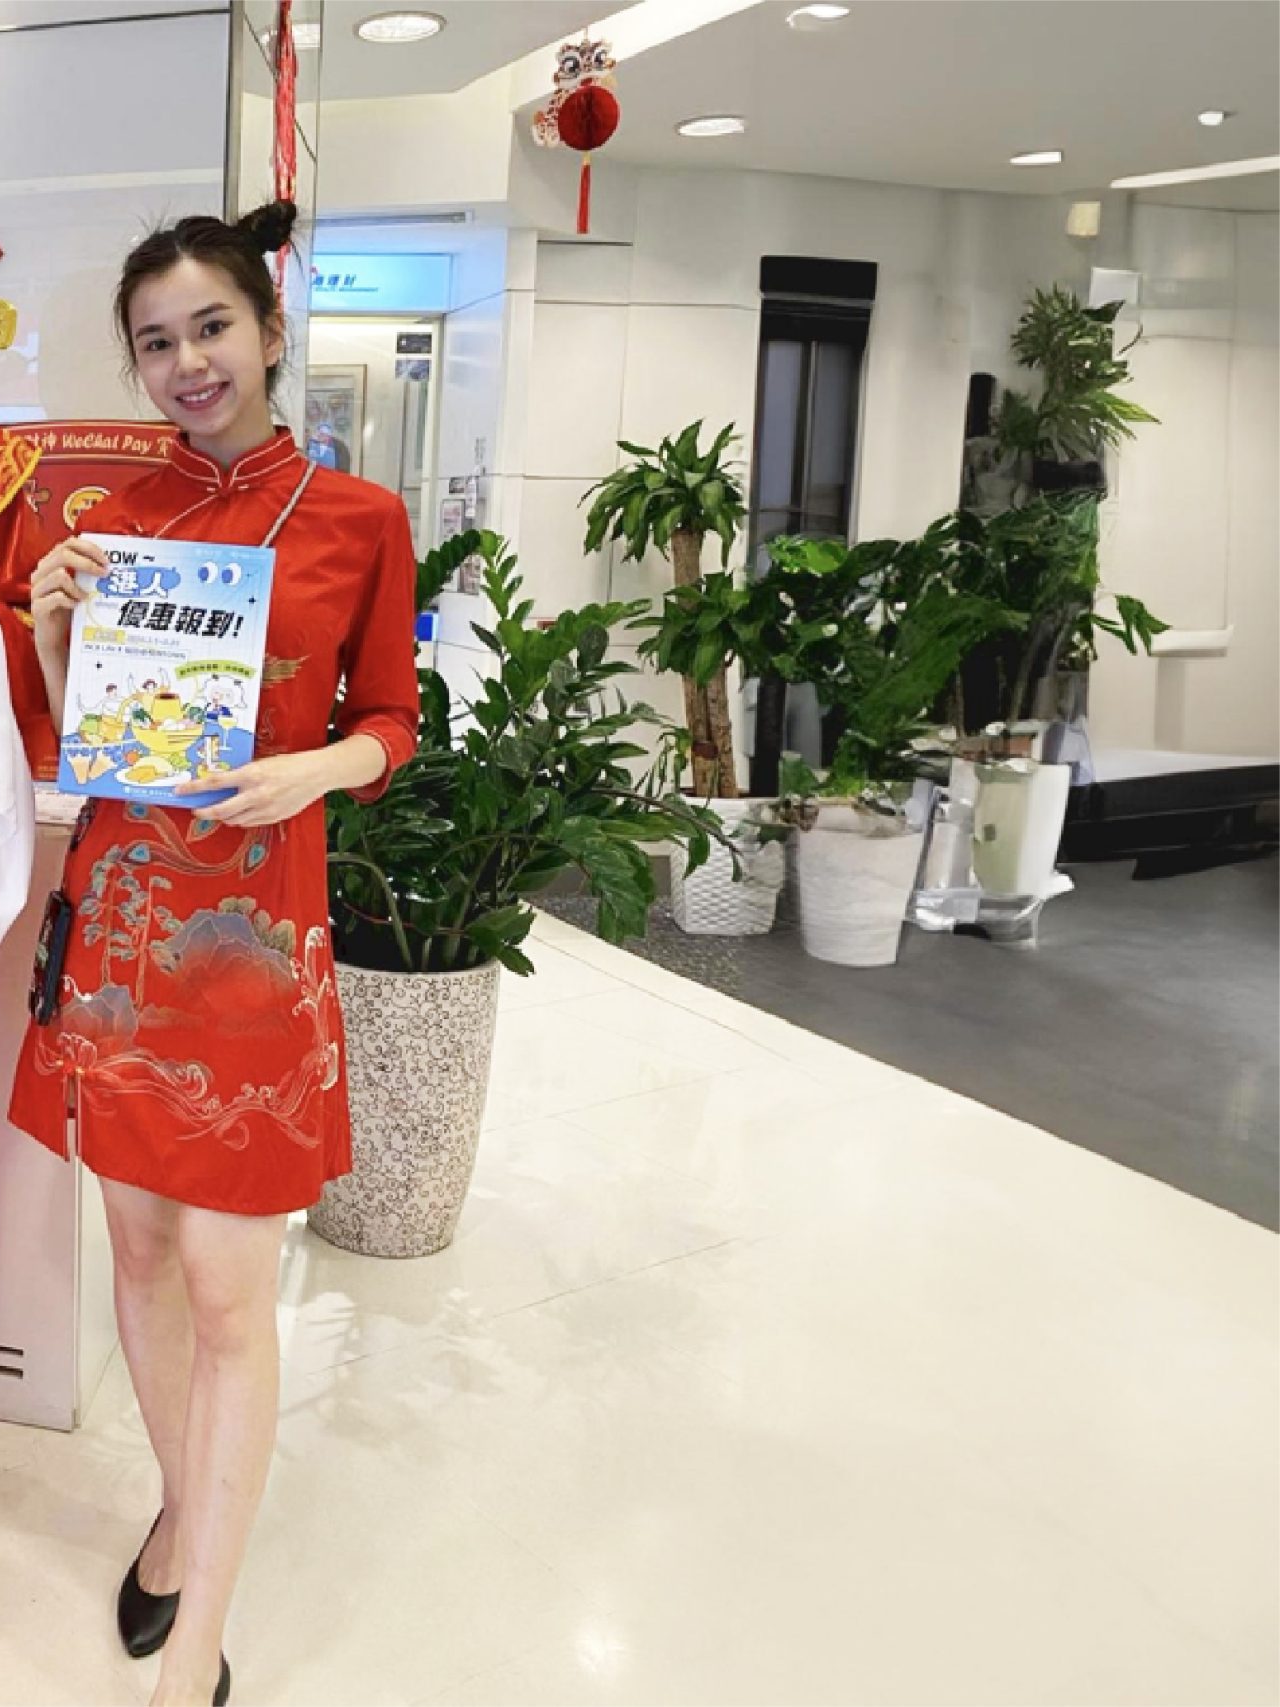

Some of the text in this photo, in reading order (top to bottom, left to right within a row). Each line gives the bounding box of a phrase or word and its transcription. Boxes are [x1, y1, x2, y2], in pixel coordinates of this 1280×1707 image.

[62, 433, 120, 449] WeChat
[122, 435, 152, 455] Pay
[106, 550, 138, 565] OW
[117, 599, 244, 639] 優惠報到!
